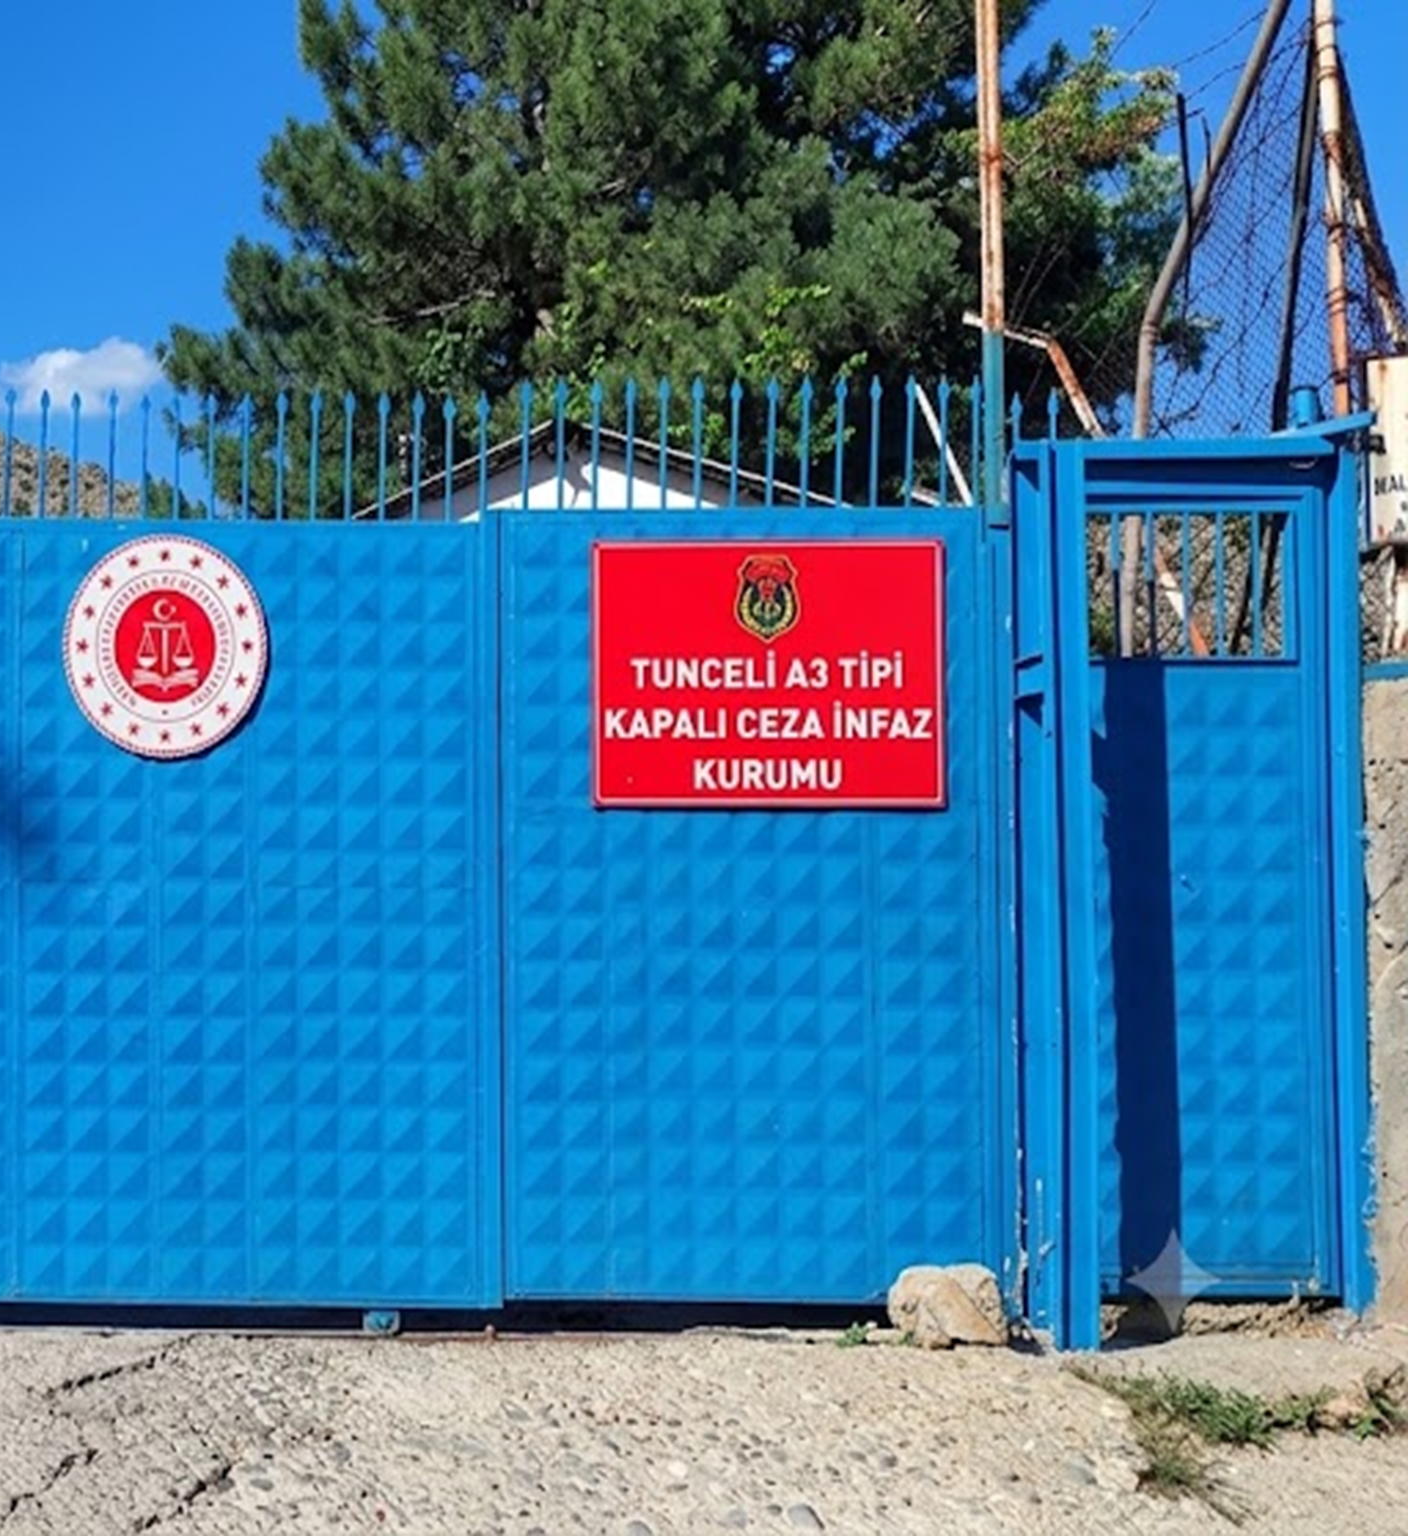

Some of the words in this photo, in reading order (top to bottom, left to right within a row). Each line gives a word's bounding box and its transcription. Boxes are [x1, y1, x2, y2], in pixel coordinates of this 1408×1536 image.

[630, 650, 776, 689] TUNCELİ
[785, 658, 829, 689] A3
[838, 651, 903, 689] TİPİ
[604, 707, 727, 740] KAPALI
[737, 707, 825, 740] CEZA
[833, 701, 933, 740] İNFAZ
[693, 758, 843, 791] KURUMU
